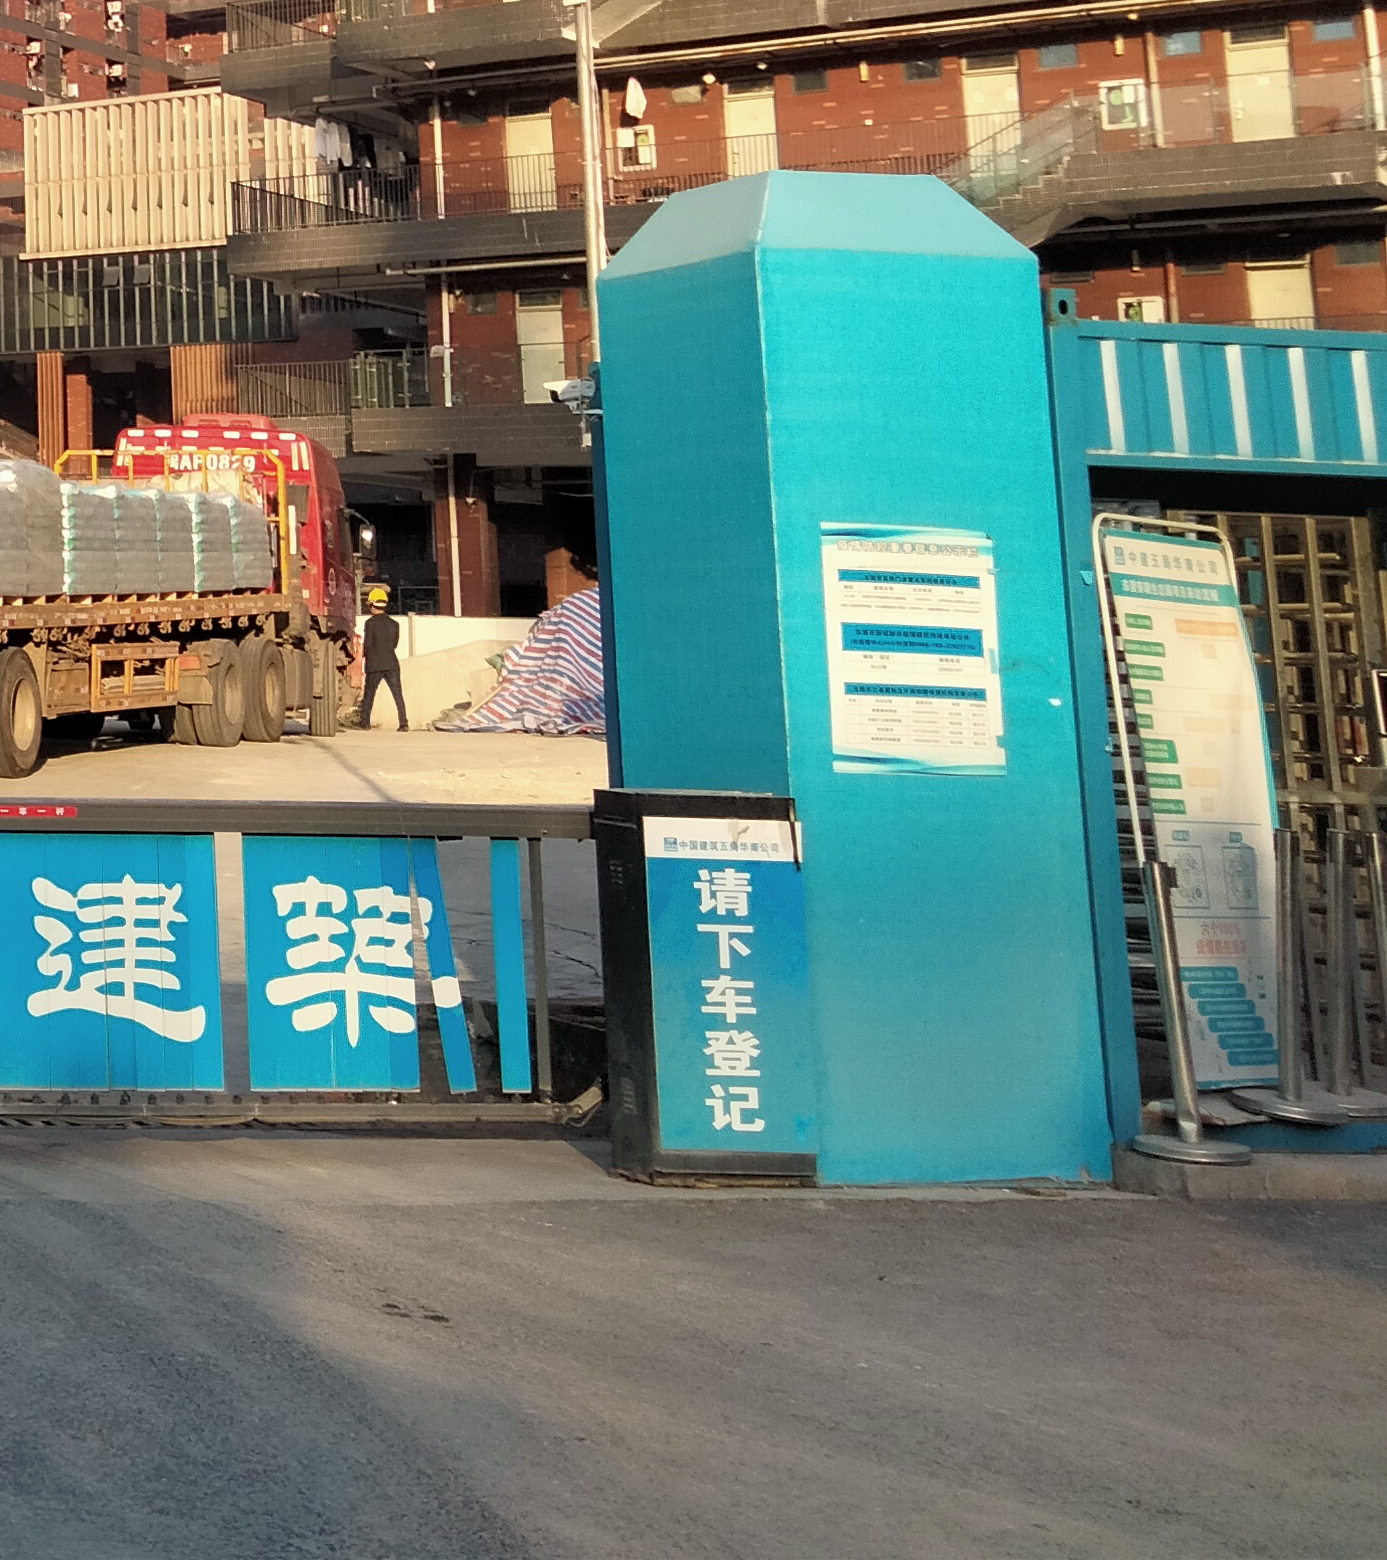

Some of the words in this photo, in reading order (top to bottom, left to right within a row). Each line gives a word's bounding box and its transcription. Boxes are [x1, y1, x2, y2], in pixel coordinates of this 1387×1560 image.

[692, 868, 766, 1133] 请下车登记
